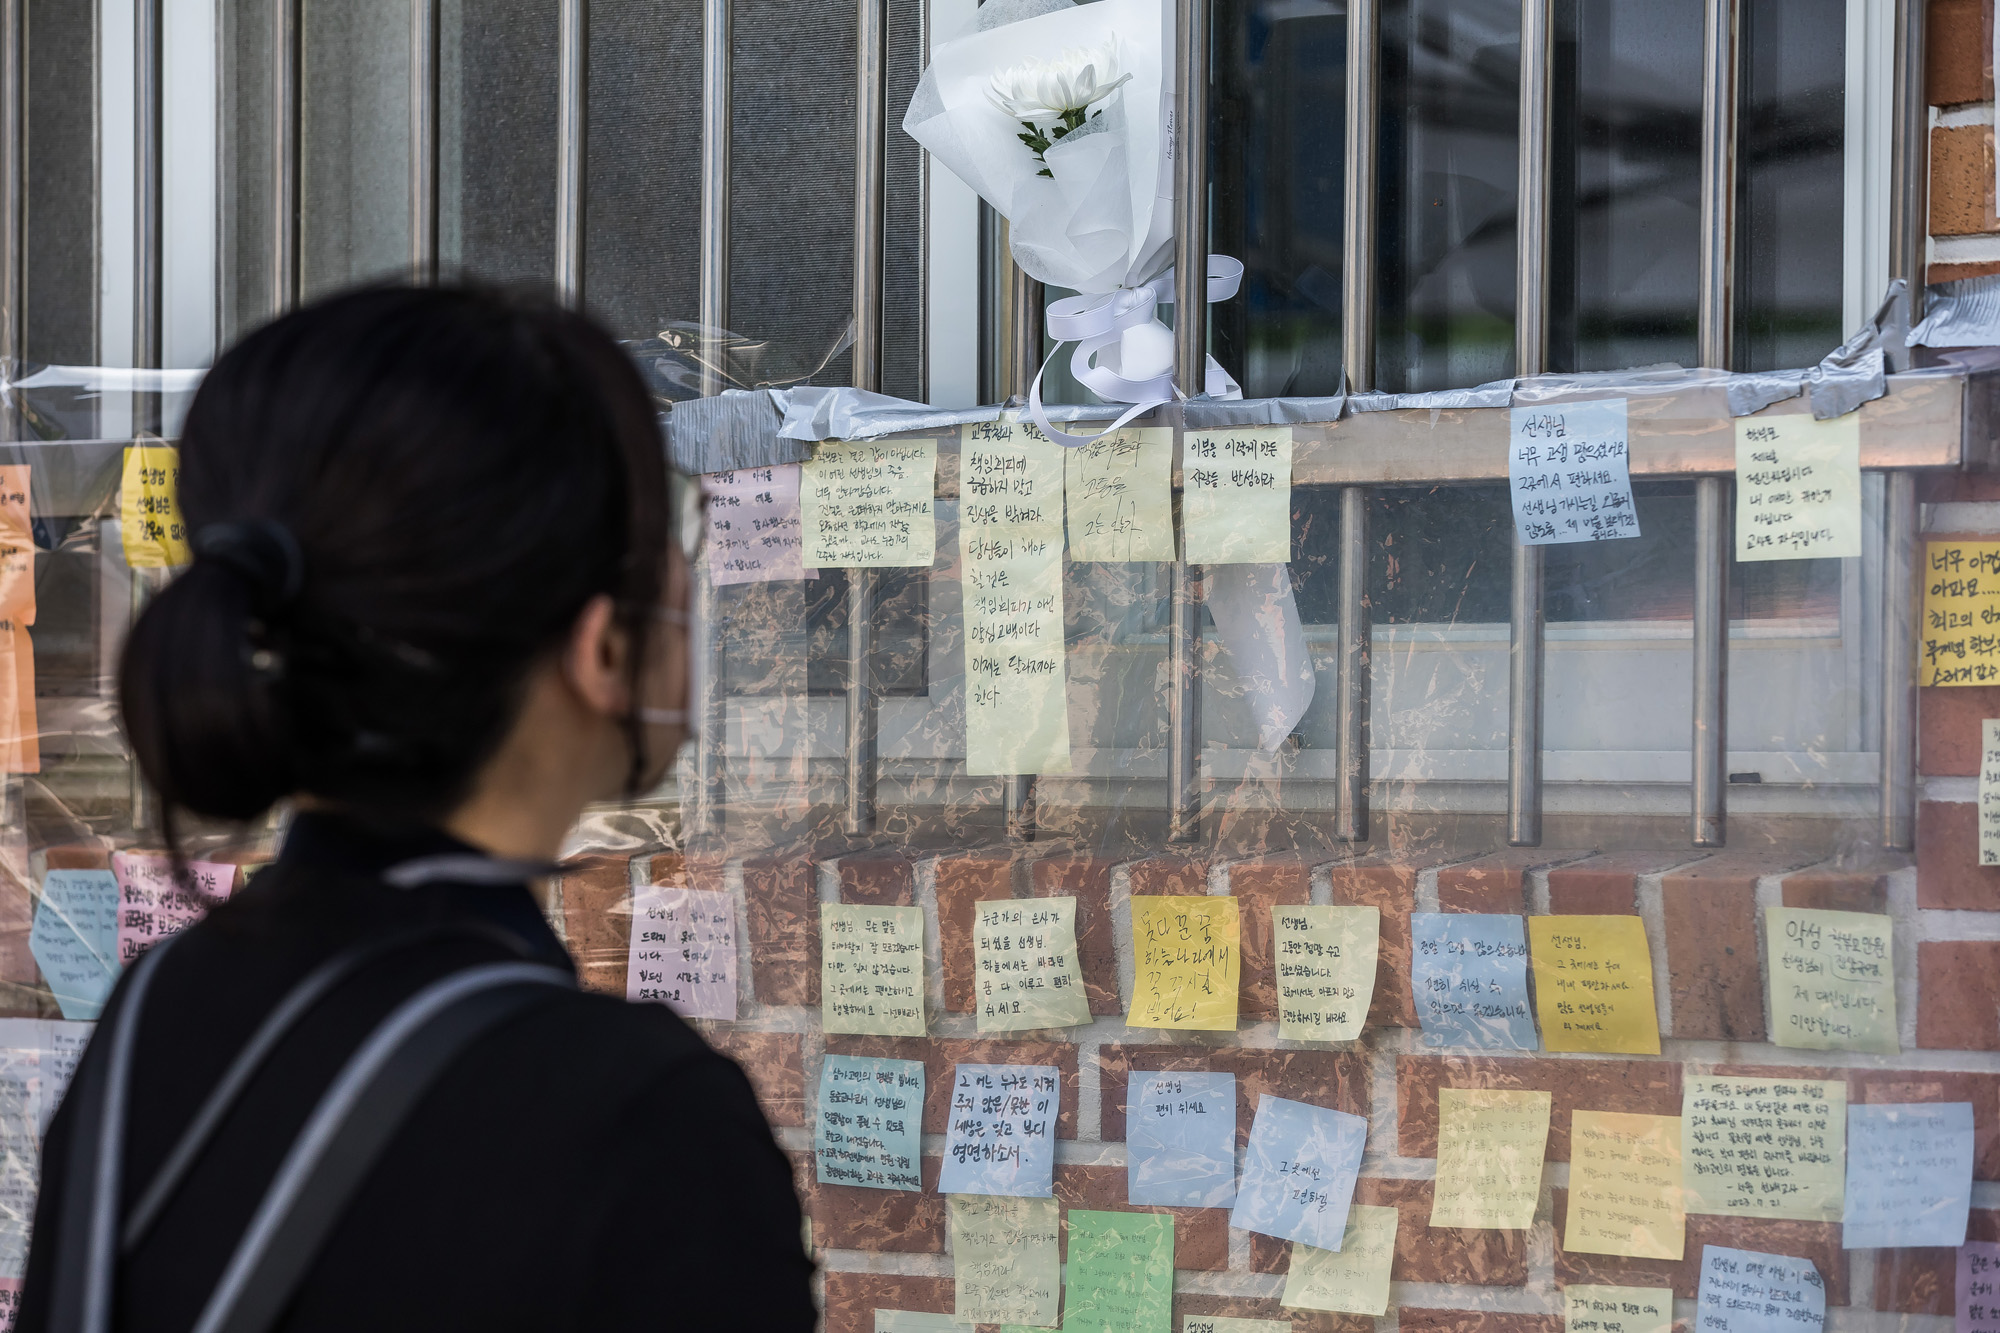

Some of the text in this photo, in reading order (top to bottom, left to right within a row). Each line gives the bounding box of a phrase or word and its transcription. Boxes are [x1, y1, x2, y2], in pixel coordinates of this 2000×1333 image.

[971, 422, 1013, 442] 교육청과
[1521, 414, 1567, 438] 선생님
[1191, 438, 1217, 458] 이분을
[1518, 442, 1568, 467] 너무 고생
[970, 451, 1027, 475] 책임회피에
[967, 476, 1033, 497] 급급하지 말고
[1231, 468, 1275, 491] 반성하라.
[1518, 472, 1562, 491] 그곳에서
[967, 504, 1044, 525] 진상을 밝혀라.
[1521, 497, 1557, 516] 선생님
[968, 537, 1047, 561] 당신들이 해야
[1931, 549, 1964, 574] 너무
[970, 568, 1010, 590] 할 것은
[972, 594, 1032, 615] 책임회피가
[1928, 609, 1972, 632] 최고의
[972, 655, 1057, 678] 이제는 달라져야
[974, 684, 1003, 709] 한다.
[881, 919, 896, 935] 말을
[982, 910, 1060, 927] 누군가의 은사가
[1195, 914, 1211, 945] 꿈
[1786, 919, 1821, 951] 악성
[869, 941, 879, 954] 잘
[980, 934, 1047, 951] 되셨을 선생님.
[1281, 940, 1341, 958] 그동안 정말 수고
[1420, 940, 1465, 956] 정말 고생
[638, 951, 664, 962] 니다.
[981, 955, 1065, 974] 하늘에서는 바라던
[1145, 944, 1229, 980] 하늘나라에서
[1557, 960, 1567, 969] 그
[982, 973, 1072, 996] 꿈 다 이루고 편히
[1425, 976, 1451, 992] 편히
[1489, 978, 1502, 995] 수
[1792, 984, 1810, 1002] 제
[984, 1000, 1027, 1018] 쉬세요.
[959, 1074, 1055, 1093] 그 어느 누구도 지켜
[1155, 1079, 1182, 1095] 선생님
[954, 1093, 975, 1113] 주지
[1037, 1098, 1049, 1115] 이
[1155, 1100, 1208, 1117] 편히 쉬세요
[872, 1117, 881, 1131] 수
[954, 1119, 1046, 1138] 세상은 잊고 부디
[952, 1142, 1029, 1169] 영면하소서.
[1280, 1161, 1289, 1172] 그
[959, 1200, 979, 1217] 학교
[1291, 1188, 1328, 1214] 편하길
[960, 1230, 998, 1247] 책임지고
